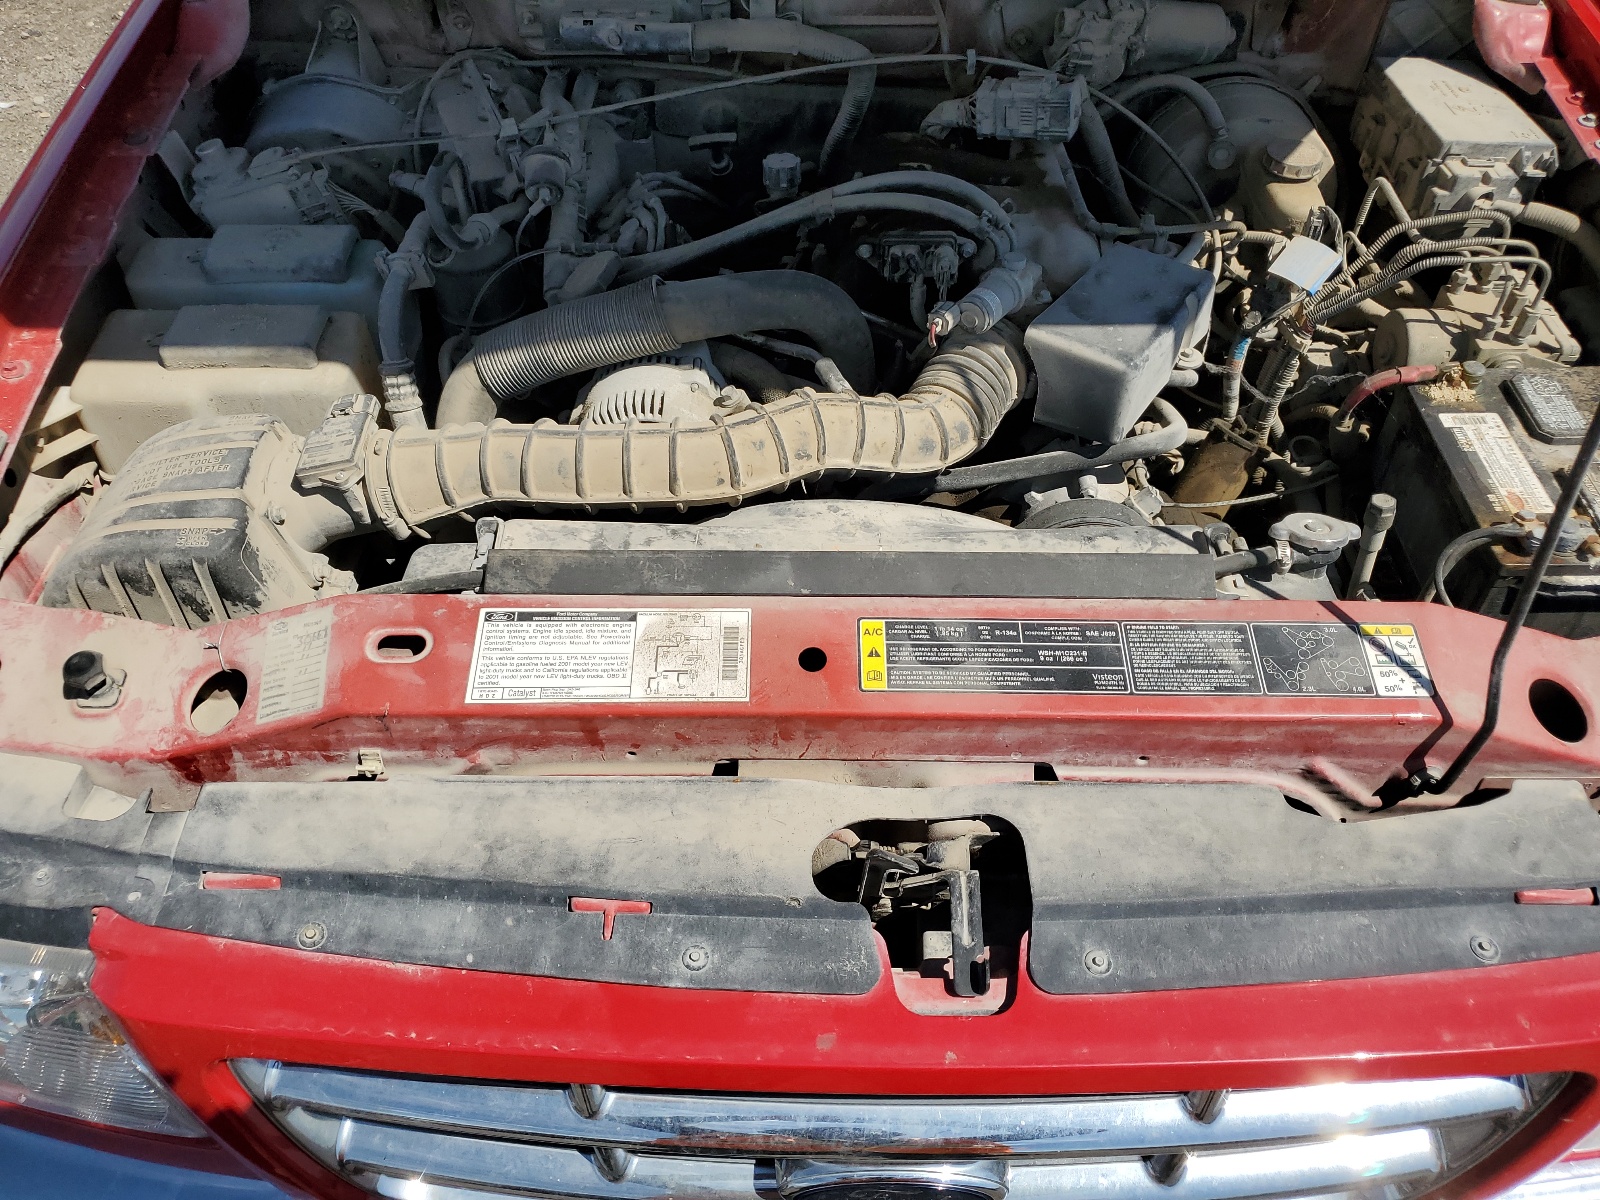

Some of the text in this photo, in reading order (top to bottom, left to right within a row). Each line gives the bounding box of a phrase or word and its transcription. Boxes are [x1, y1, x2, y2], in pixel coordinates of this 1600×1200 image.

[166, 462, 184, 471] USE
[190, 456, 222, 466] TOOLS
[163, 468, 194, 478] SNAPS
[198, 464, 230, 473] AFTER
[181, 527, 208, 535] SNAP
[863, 628, 883, 636] A/C
[508, 688, 537, 699] Catalyst
